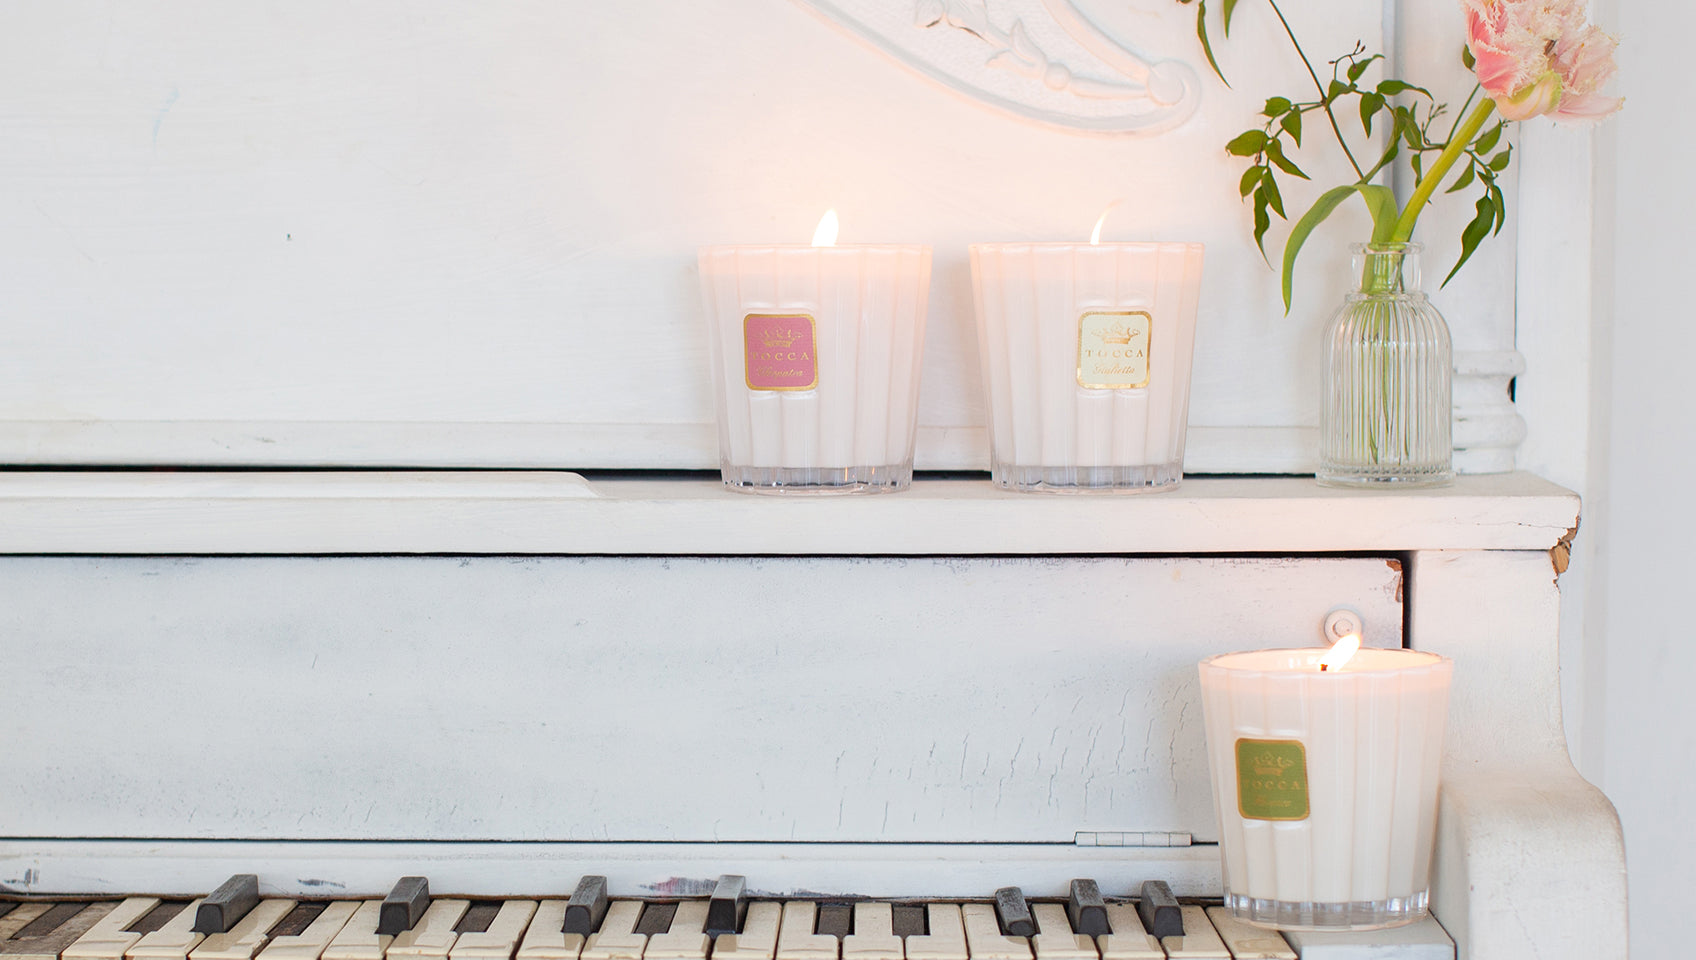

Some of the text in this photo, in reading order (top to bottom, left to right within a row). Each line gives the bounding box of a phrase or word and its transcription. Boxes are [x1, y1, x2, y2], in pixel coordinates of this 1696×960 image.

[752, 351, 810, 361] TOCCA
[1085, 349, 1143, 359] TOCCA
[1243, 778, 1301, 791] TOCCA
